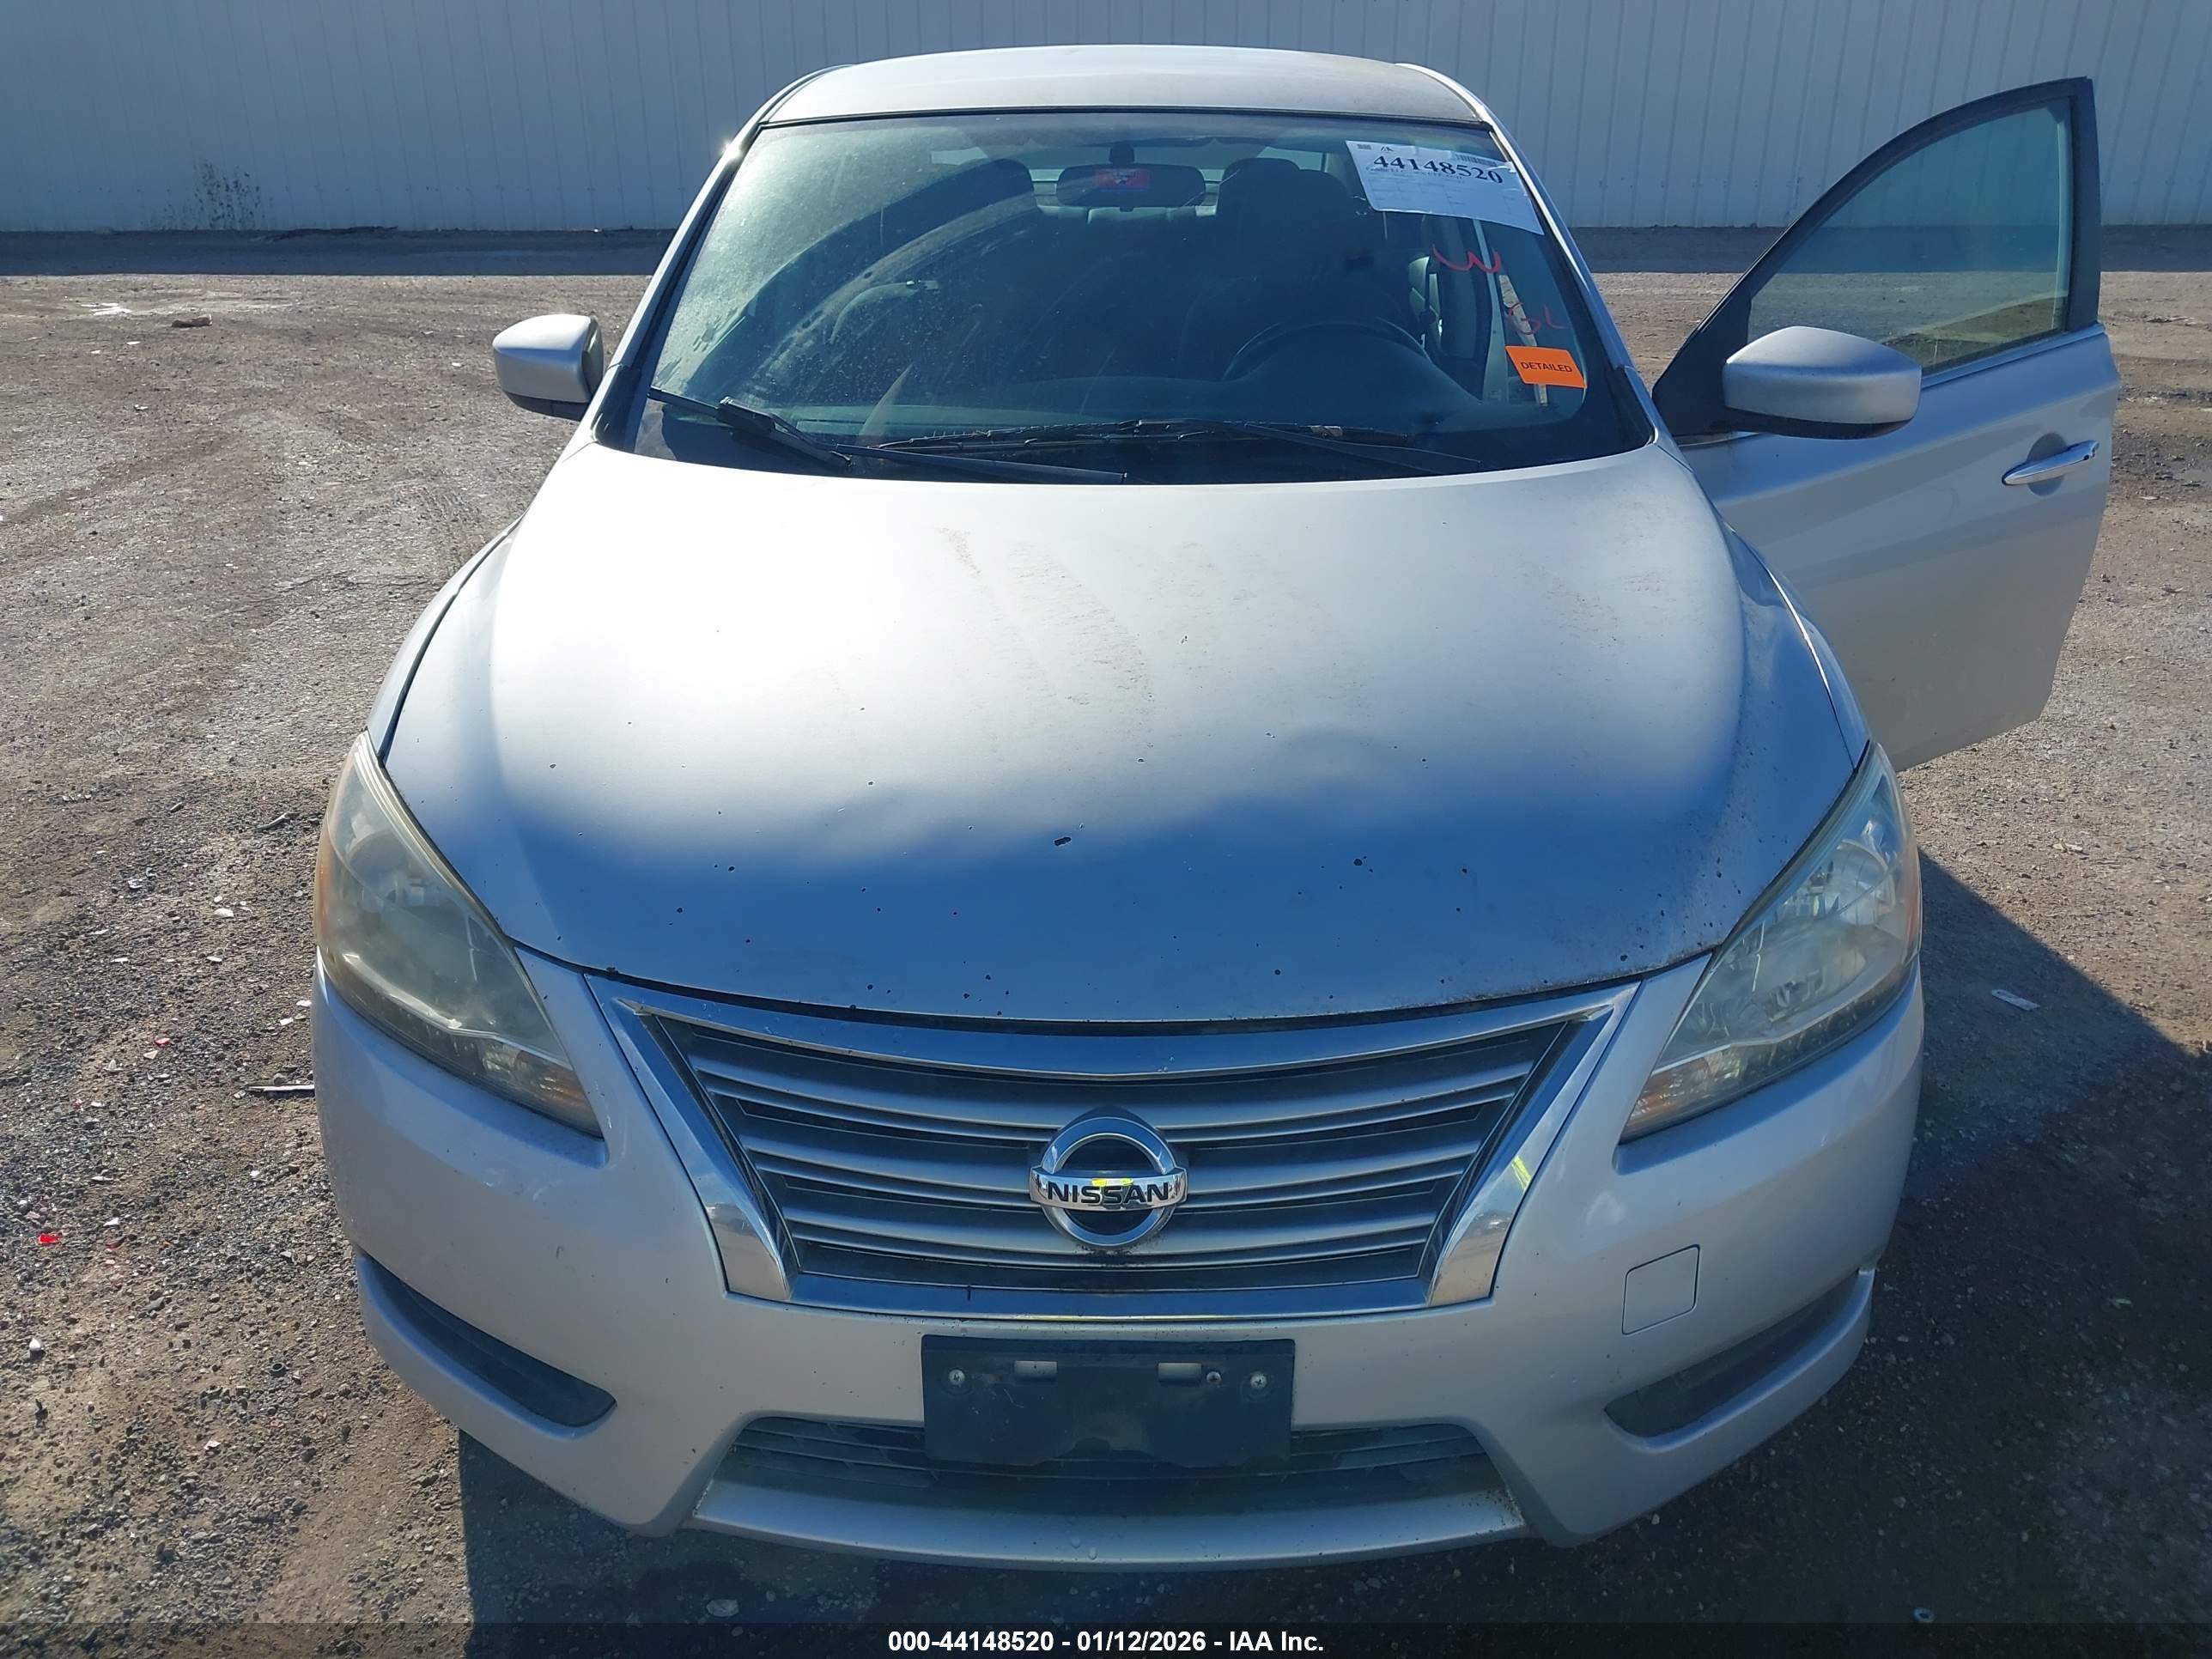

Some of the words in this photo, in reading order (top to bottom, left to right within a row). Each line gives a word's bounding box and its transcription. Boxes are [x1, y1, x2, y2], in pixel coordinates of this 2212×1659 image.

[1373, 155, 1504, 184] 44148520
[1520, 361, 1573, 374] DETAILED
[1047, 1181, 1170, 1204] NISSAN
